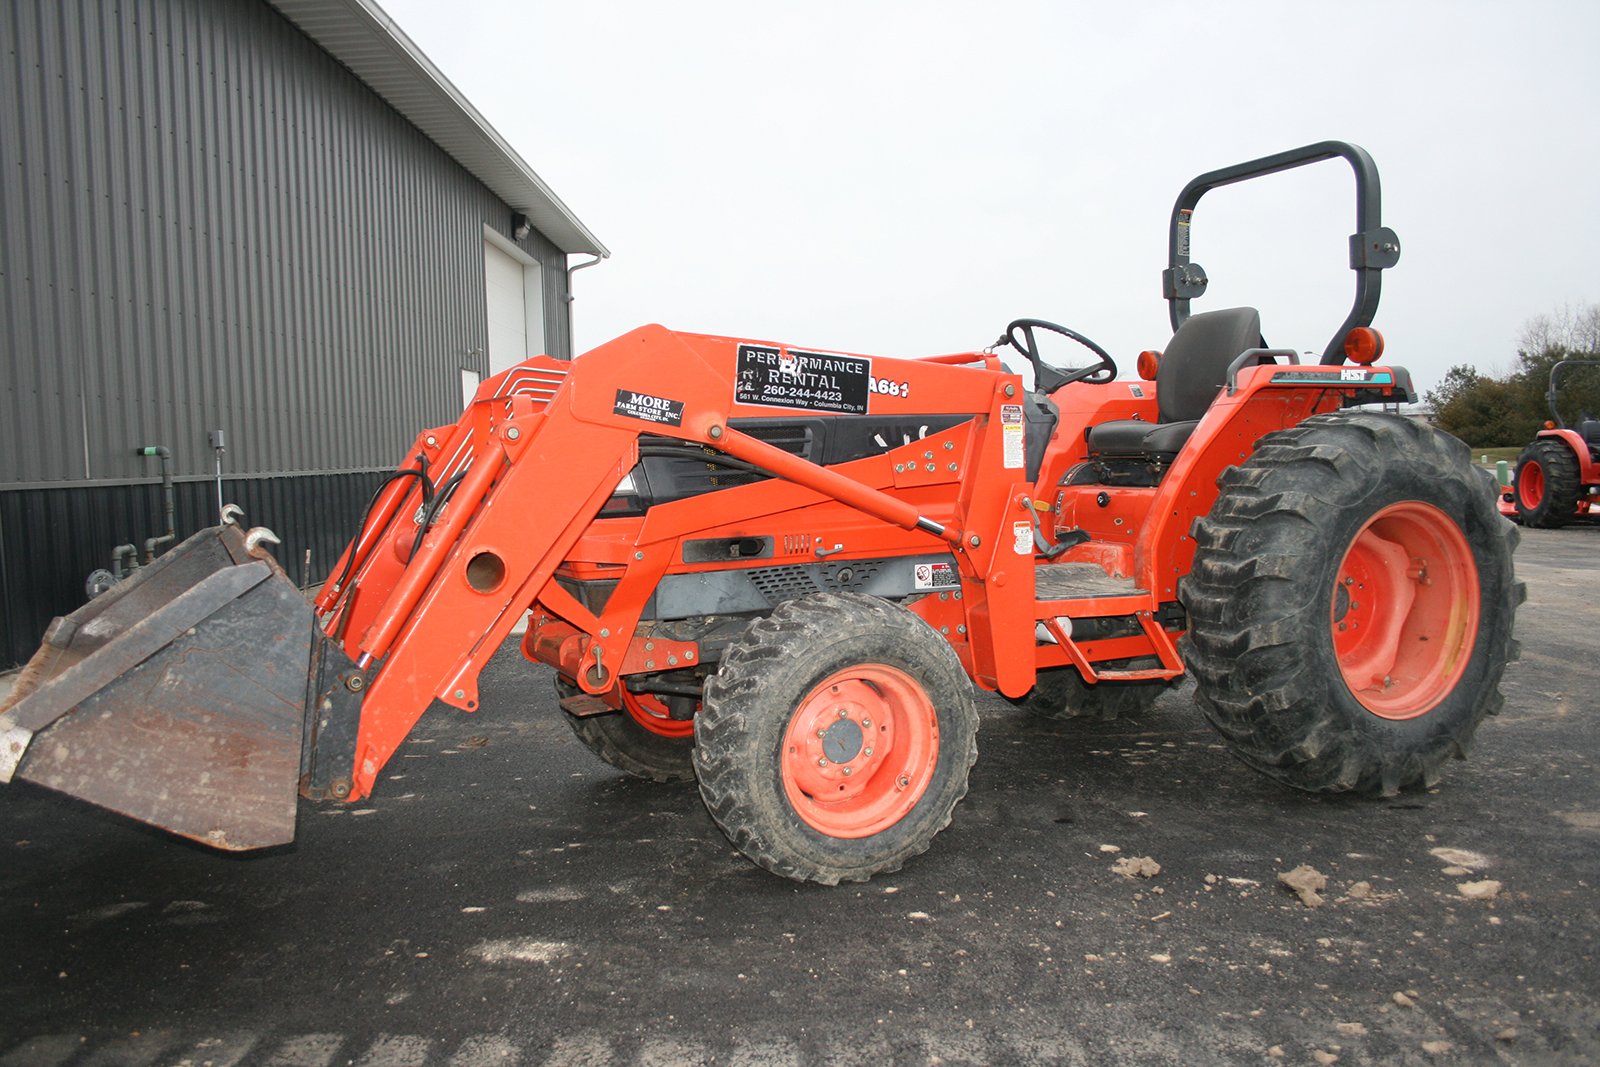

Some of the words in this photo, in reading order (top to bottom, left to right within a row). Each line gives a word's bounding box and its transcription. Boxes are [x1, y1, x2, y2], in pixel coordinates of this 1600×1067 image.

[768, 368, 840, 390] RENTAL
[1341, 370, 1367, 381] HST
[763, 384, 842, 401] 260-244-4423
[631, 393, 671, 411] MORE
[761, 395, 795, 404] Connexion
[796, 399, 809, 407] Way
[814, 400, 842, 409] Columbia
[616, 402, 637, 411] FARM
[638, 406, 661, 416] STORE
[665, 411, 680, 420] INC.
